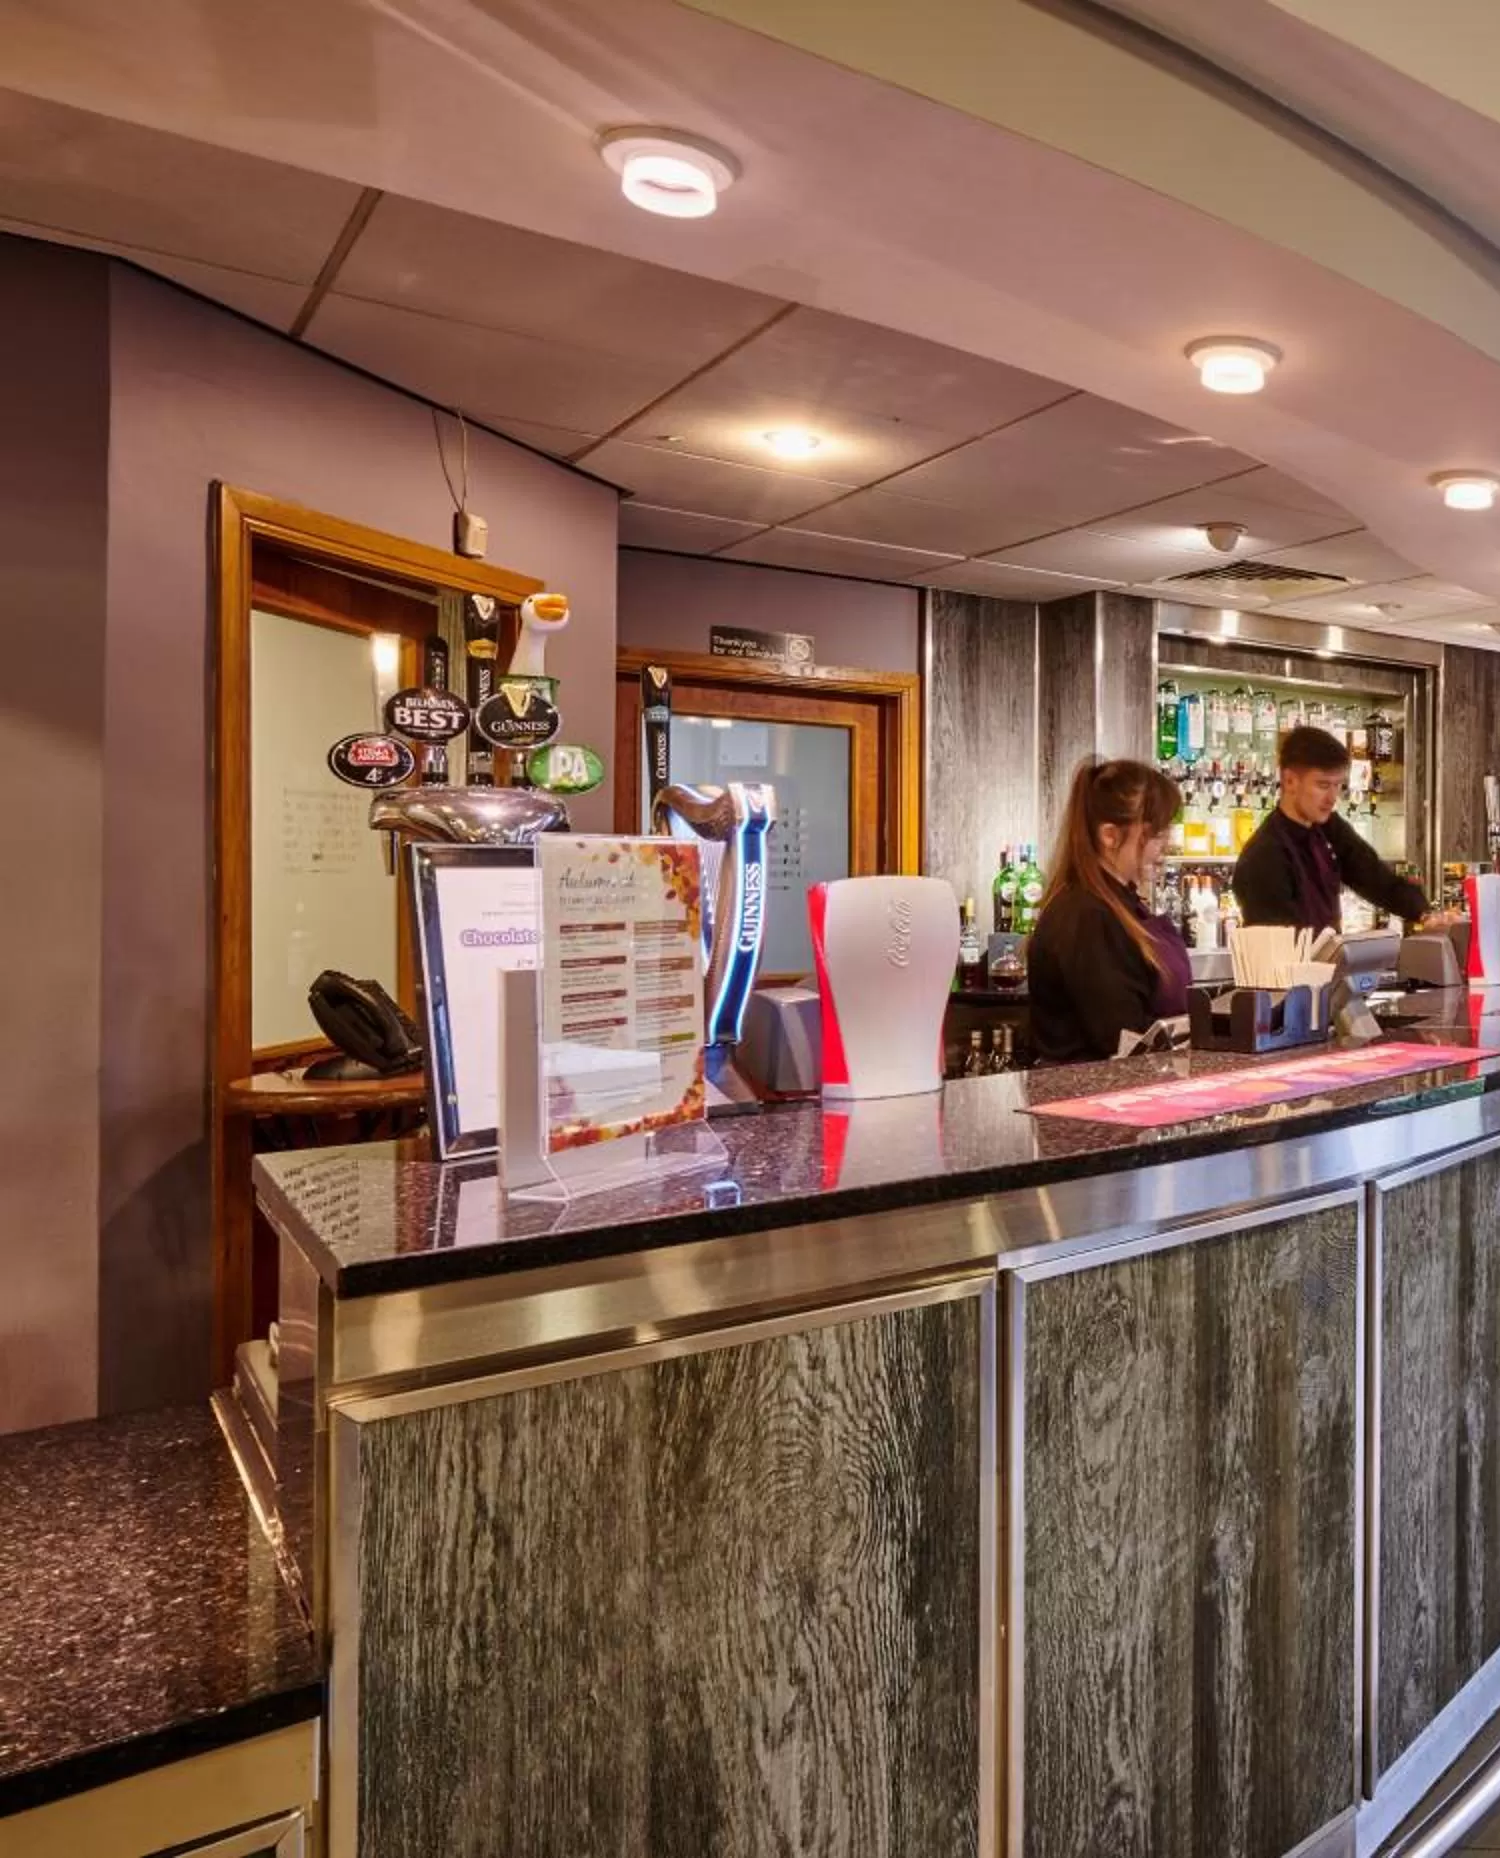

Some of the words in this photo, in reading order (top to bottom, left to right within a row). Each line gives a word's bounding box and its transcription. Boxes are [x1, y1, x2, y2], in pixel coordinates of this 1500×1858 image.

[394, 706, 465, 729] BEST
[491, 719, 550, 732] GUINNESS
[549, 745, 589, 783] IPA
[656, 732, 667, 779] GUINNESS
[738, 862, 763, 953] GUINNESS
